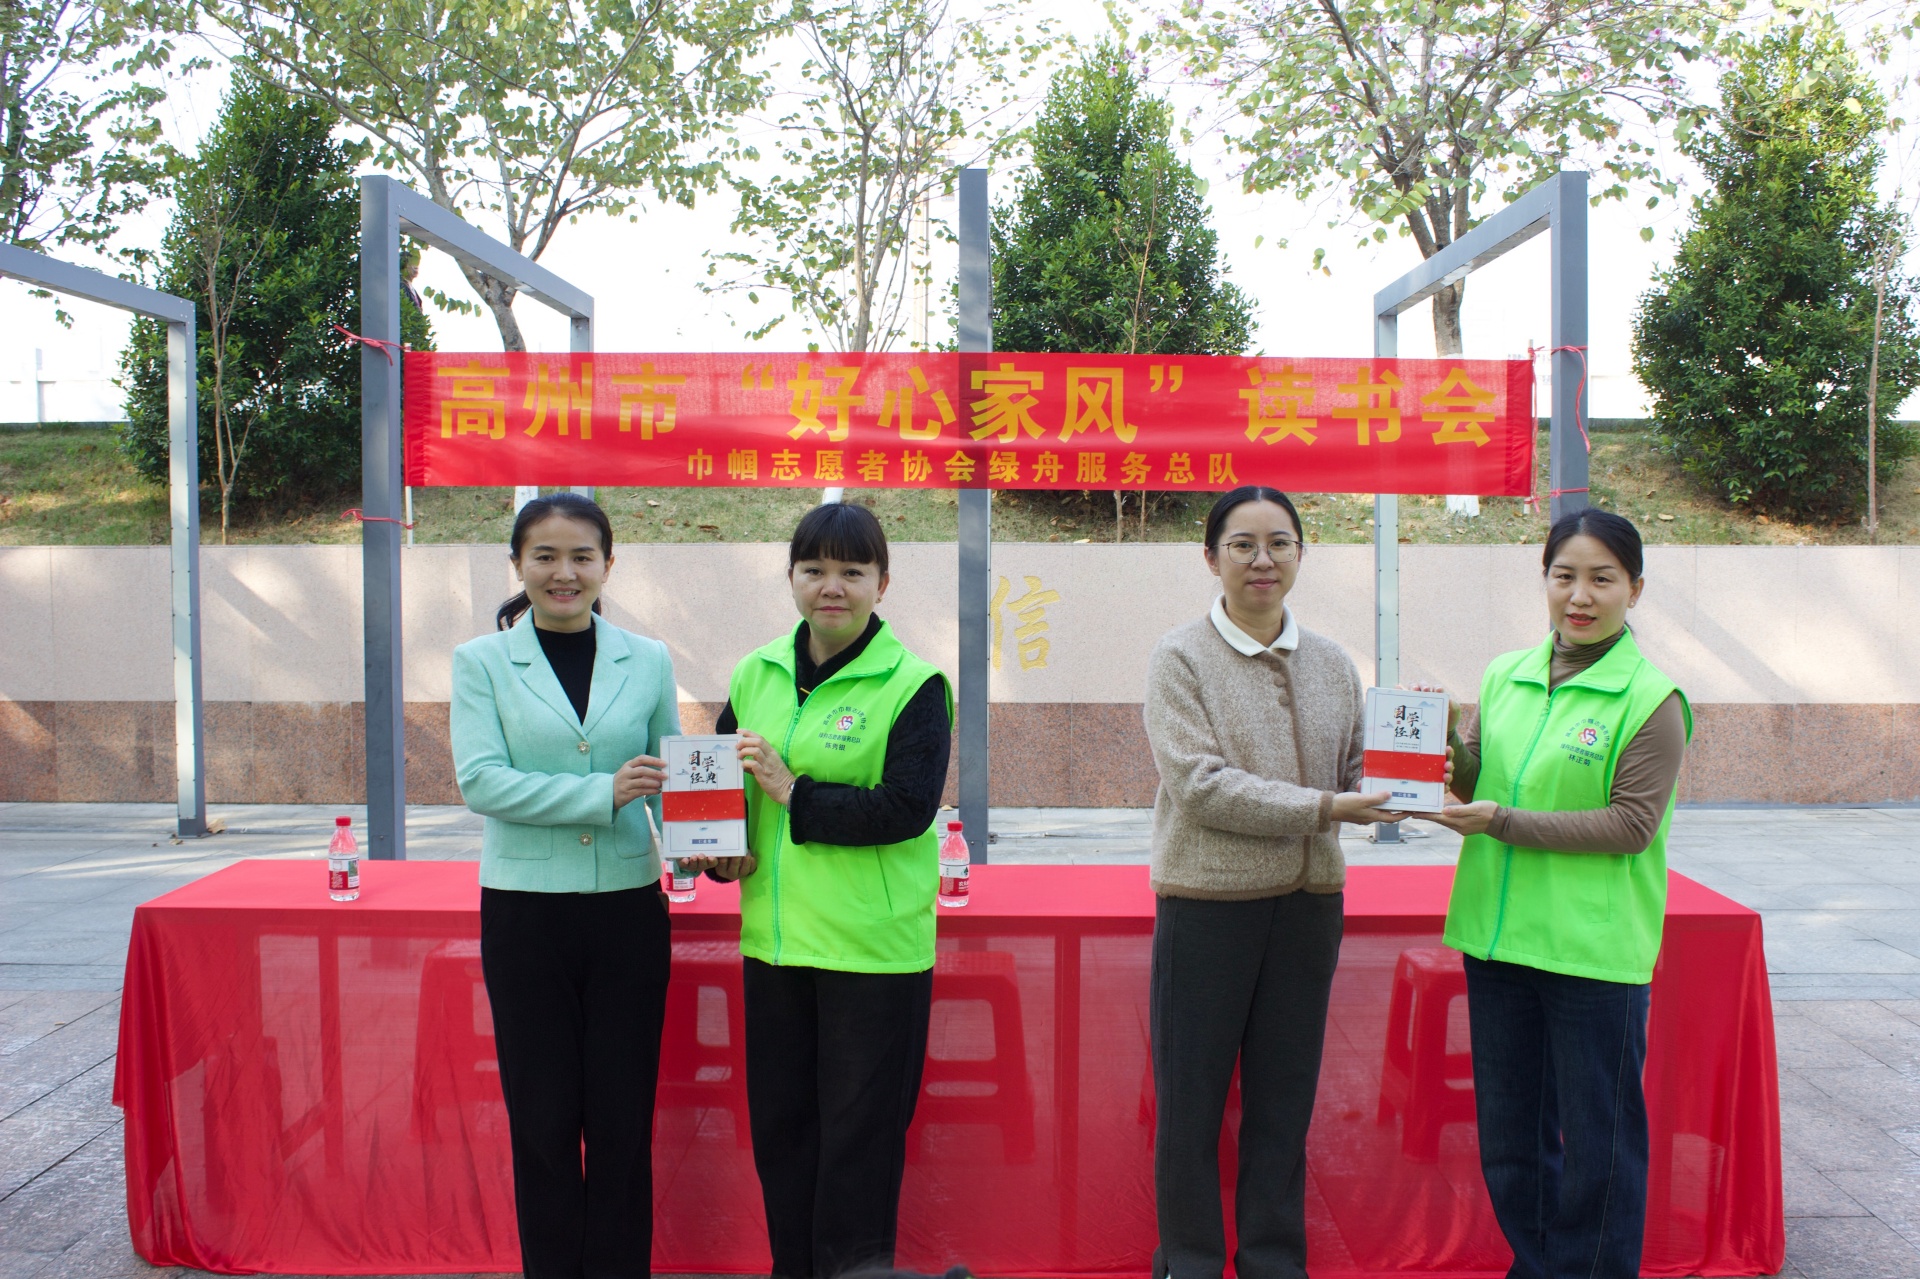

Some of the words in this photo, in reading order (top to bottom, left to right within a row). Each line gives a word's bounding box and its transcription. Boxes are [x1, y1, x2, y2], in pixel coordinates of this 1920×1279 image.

[437, 361, 1497, 447] 高州市“好心家风”读书会
[687, 448, 1239, 484] 巾帼志愿者协会绿舟服务总队
[990, 575, 1061, 673] 信
